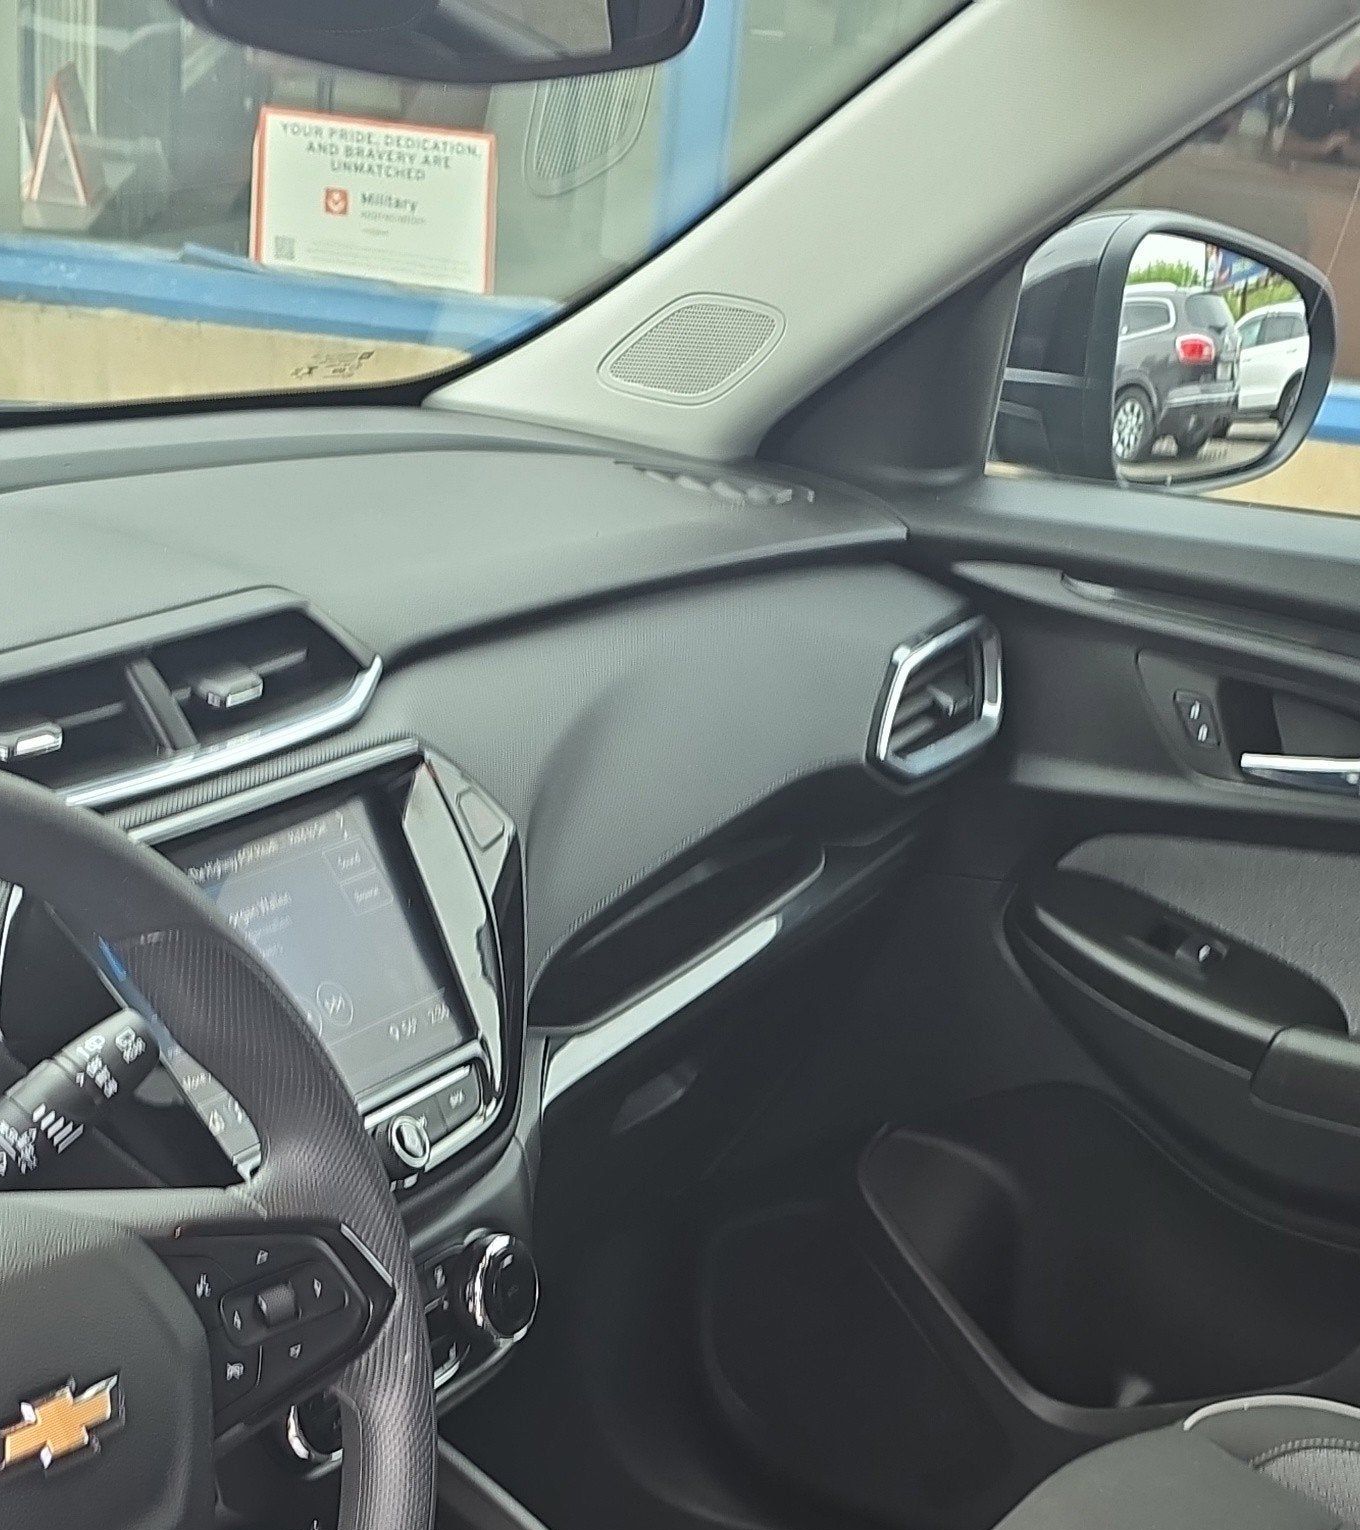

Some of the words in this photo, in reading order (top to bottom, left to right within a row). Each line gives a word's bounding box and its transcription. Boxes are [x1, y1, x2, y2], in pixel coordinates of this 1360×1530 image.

[281, 122, 323, 138] YOUR
[307, 142, 339, 157] AND
[344, 145, 417, 165] BRAVERY
[421, 154, 451, 170] ARE
[330, 159, 426, 181] UNMATCHED
[360, 191, 418, 213] Military
